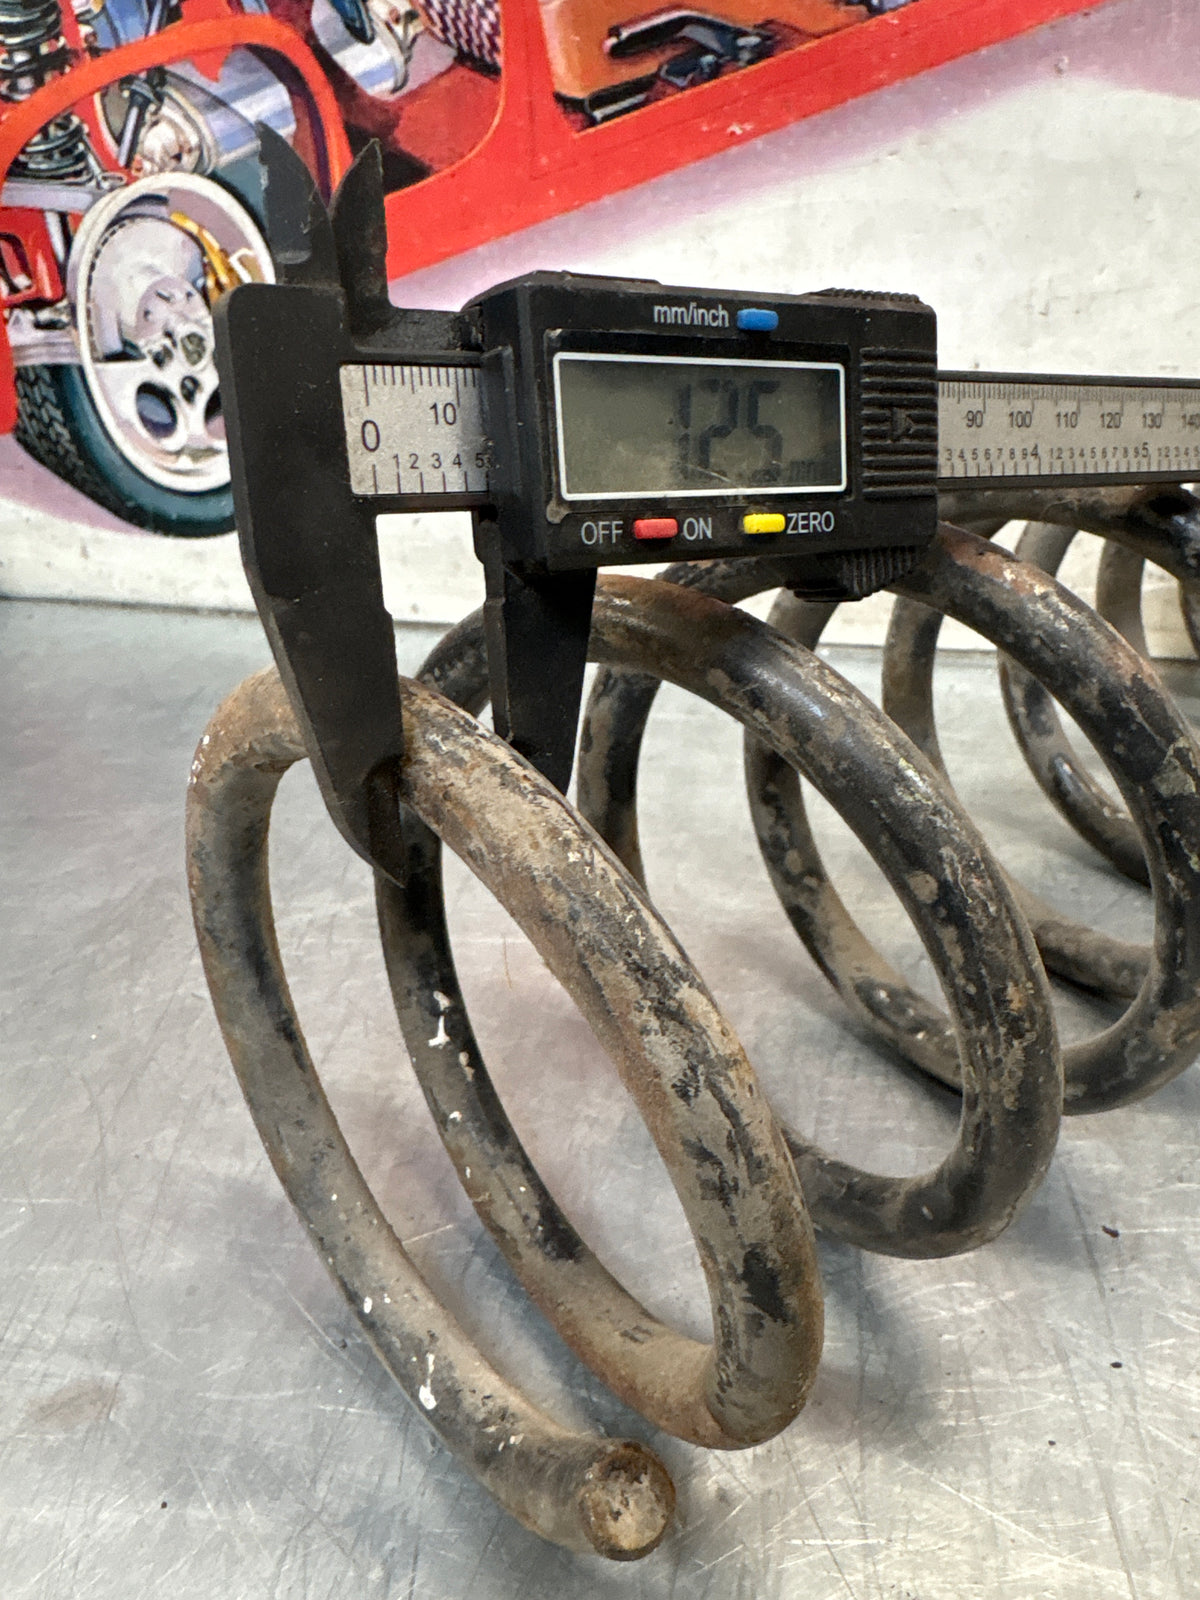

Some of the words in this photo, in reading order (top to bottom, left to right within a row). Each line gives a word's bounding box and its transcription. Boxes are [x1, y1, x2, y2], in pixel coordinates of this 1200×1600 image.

[653, 302, 729, 328] mm/inch
[429, 402, 457, 425] 10
[965, 410, 984, 428] 90
[1009, 410, 1033, 428] 100
[1055, 411, 1078, 429] 110
[1100, 411, 1122, 429] 120
[1142, 412, 1162, 429] 130
[361, 420, 380, 452] 0
[392, 453, 400, 469] 1
[409, 453, 419, 469] 2
[431, 453, 442, 469] 3
[452, 453, 462, 469] 4
[581, 520, 623, 546] OFF
[682, 517, 713, 540] ON
[786, 511, 835, 534] ZERO
